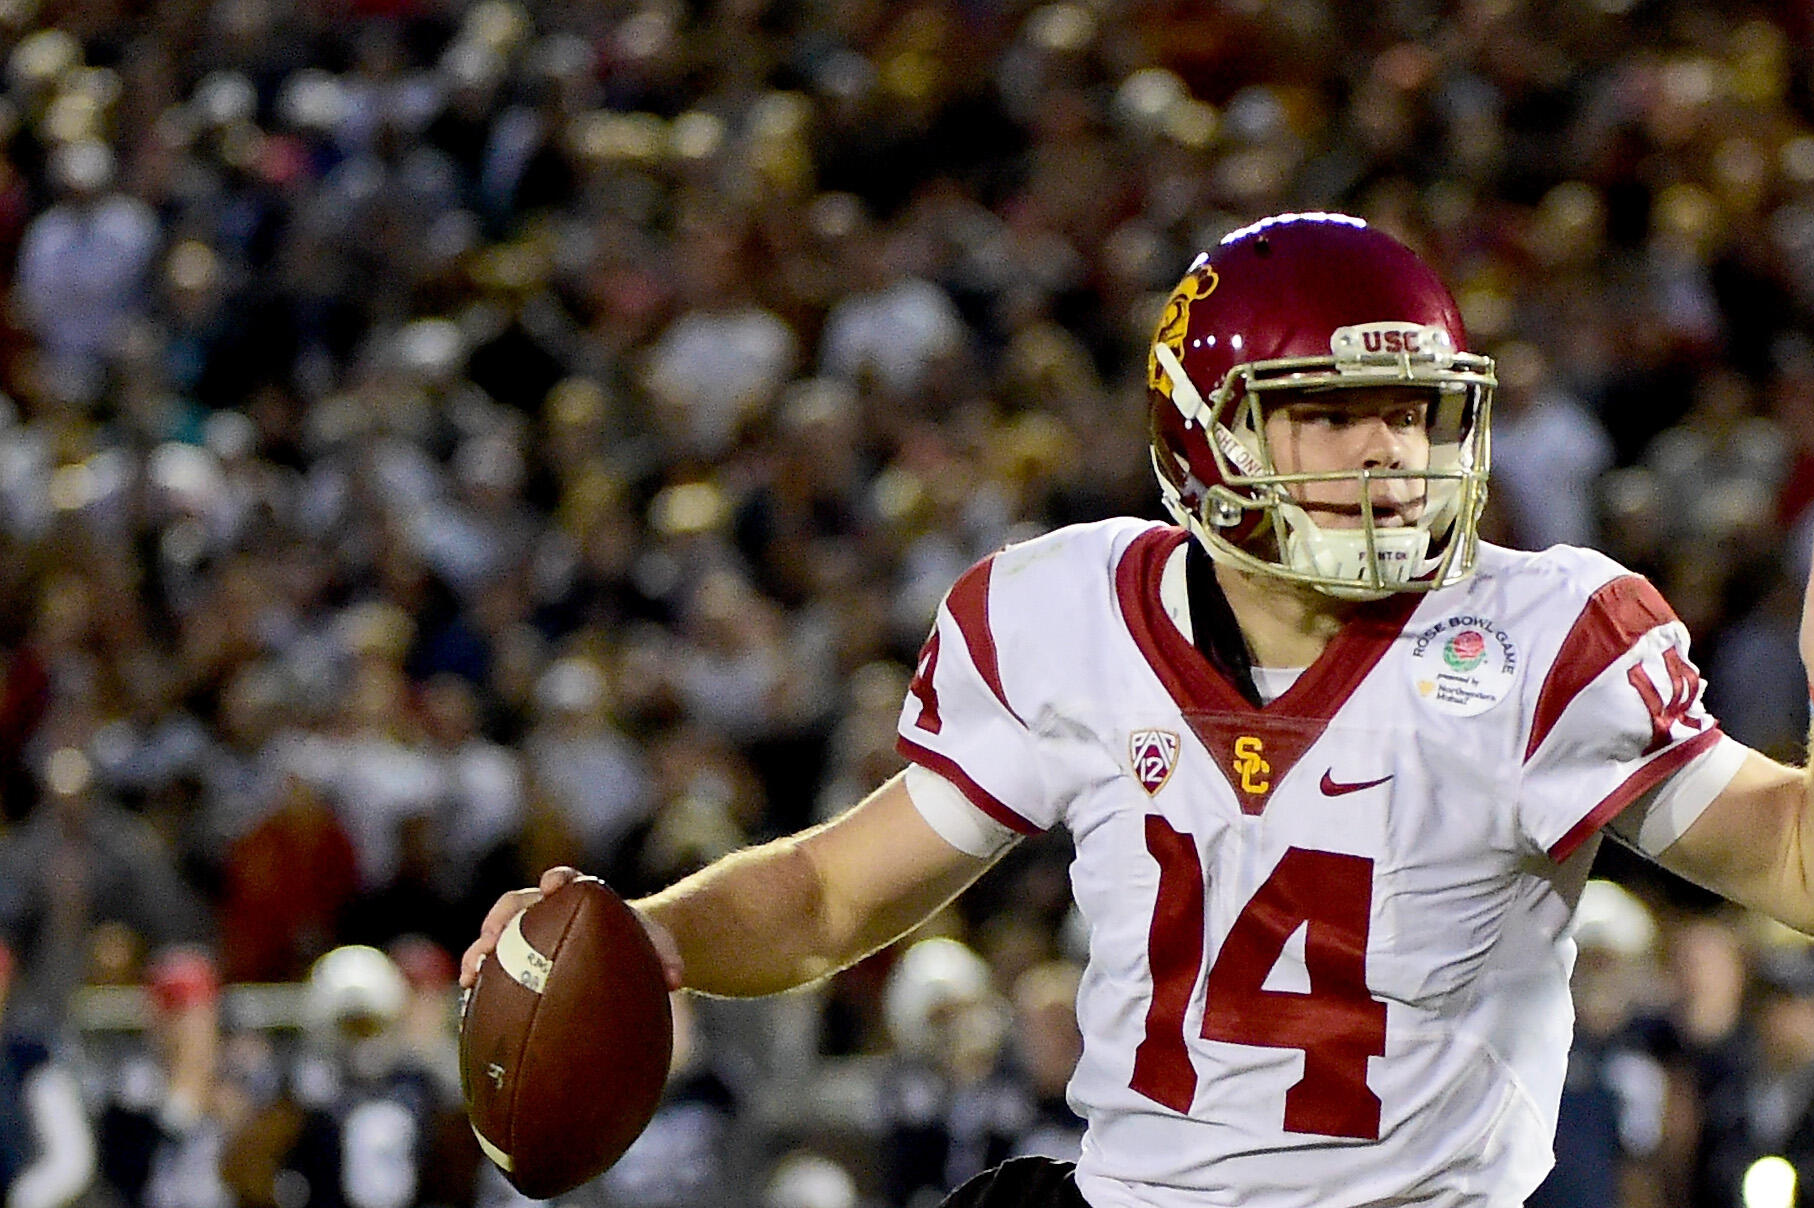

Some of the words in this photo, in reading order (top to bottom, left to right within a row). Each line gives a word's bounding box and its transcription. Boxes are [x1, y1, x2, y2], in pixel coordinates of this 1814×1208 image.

[1362, 330, 1421, 353] USC
[1412, 622, 1447, 658] ROSE
[1448, 616, 1494, 634] BOWL
[1495, 630, 1517, 675] GAME
[1626, 644, 1702, 757] 14
[1132, 730, 1177, 769] PAC
[1140, 756, 1164, 782] 12
[1233, 735, 1271, 794] SC
[1128, 813, 1388, 1140] 14
